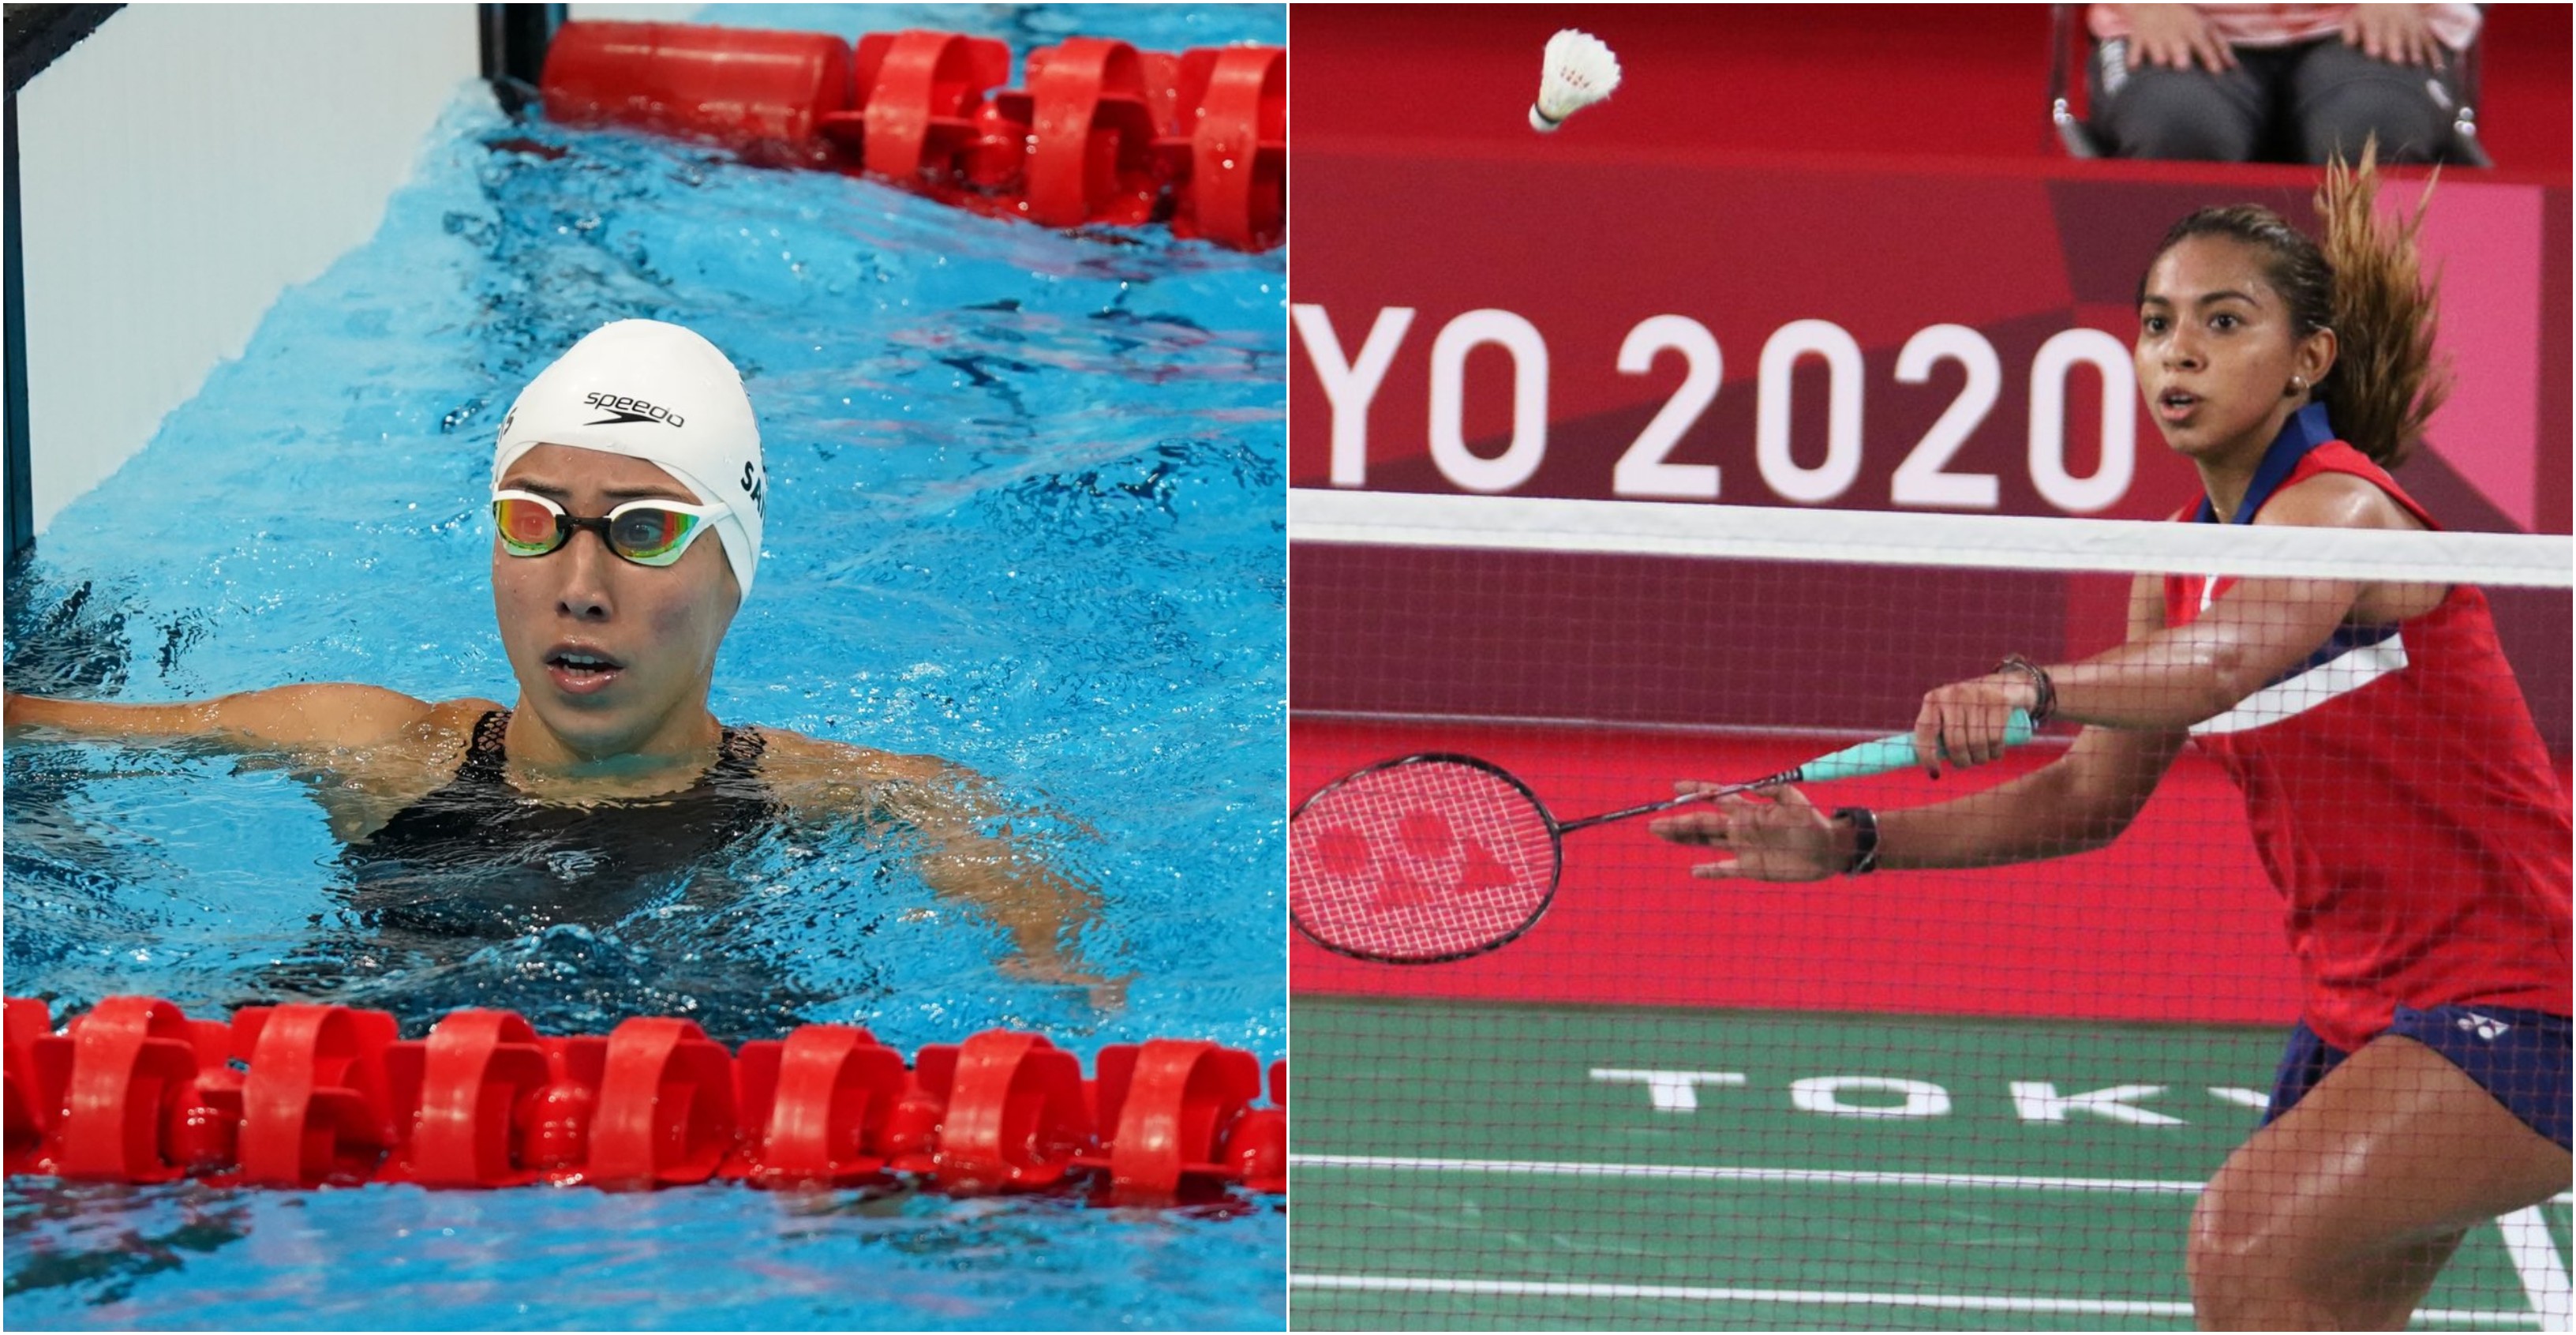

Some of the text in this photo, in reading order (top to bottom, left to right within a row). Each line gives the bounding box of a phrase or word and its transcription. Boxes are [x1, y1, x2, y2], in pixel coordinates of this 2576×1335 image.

[583, 392, 684, 427] speedo
[1612, 313, 2137, 512] 2020
[740, 460, 766, 527] SA
